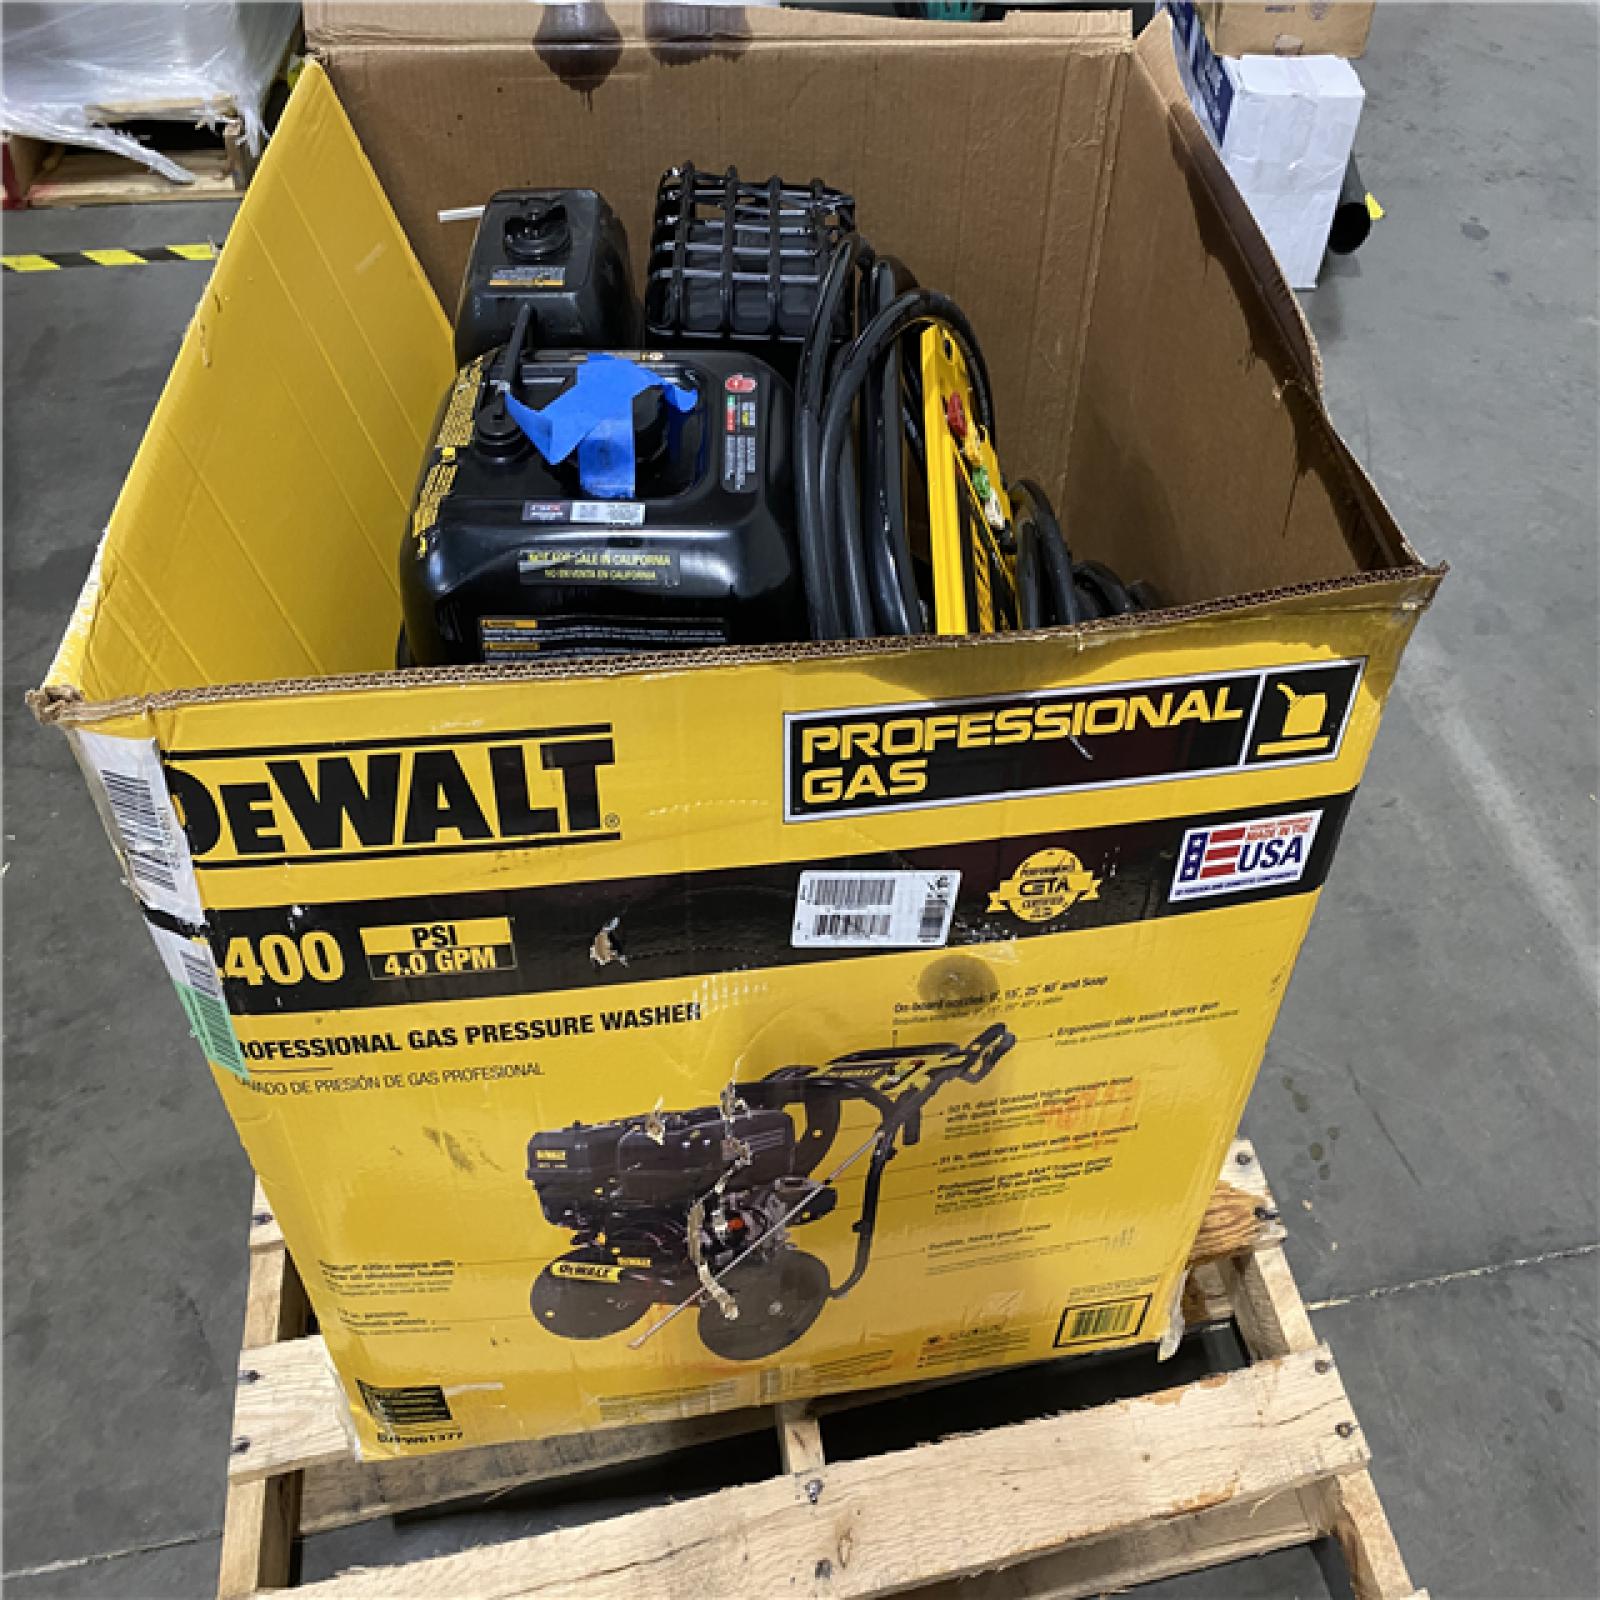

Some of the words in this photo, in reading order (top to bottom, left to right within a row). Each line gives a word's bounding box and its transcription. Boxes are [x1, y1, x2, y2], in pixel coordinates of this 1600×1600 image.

[614, 554, 672, 567] CALIFORNIA
[801, 686, 1243, 764] PROFESSIONAL
[801, 759, 928, 804] GAS
[1238, 834, 1304, 873] USA
[1020, 875, 1068, 896] CETA
[412, 923, 457, 948] PSI
[215, 929, 345, 986] 400
[384, 953, 427, 977] 4.0
[435, 945, 498, 973] GPM
[408, 1027, 458, 1050] GAS
[464, 1014, 596, 1046] PRESSURE
[600, 1002, 701, 1032] WASHER
[289, 1079, 313, 1095] DE
[384, 1072, 405, 1088] DE
[408, 1069, 439, 1086] GAS
[442, 1061, 545, 1083] PROFESIONAL
